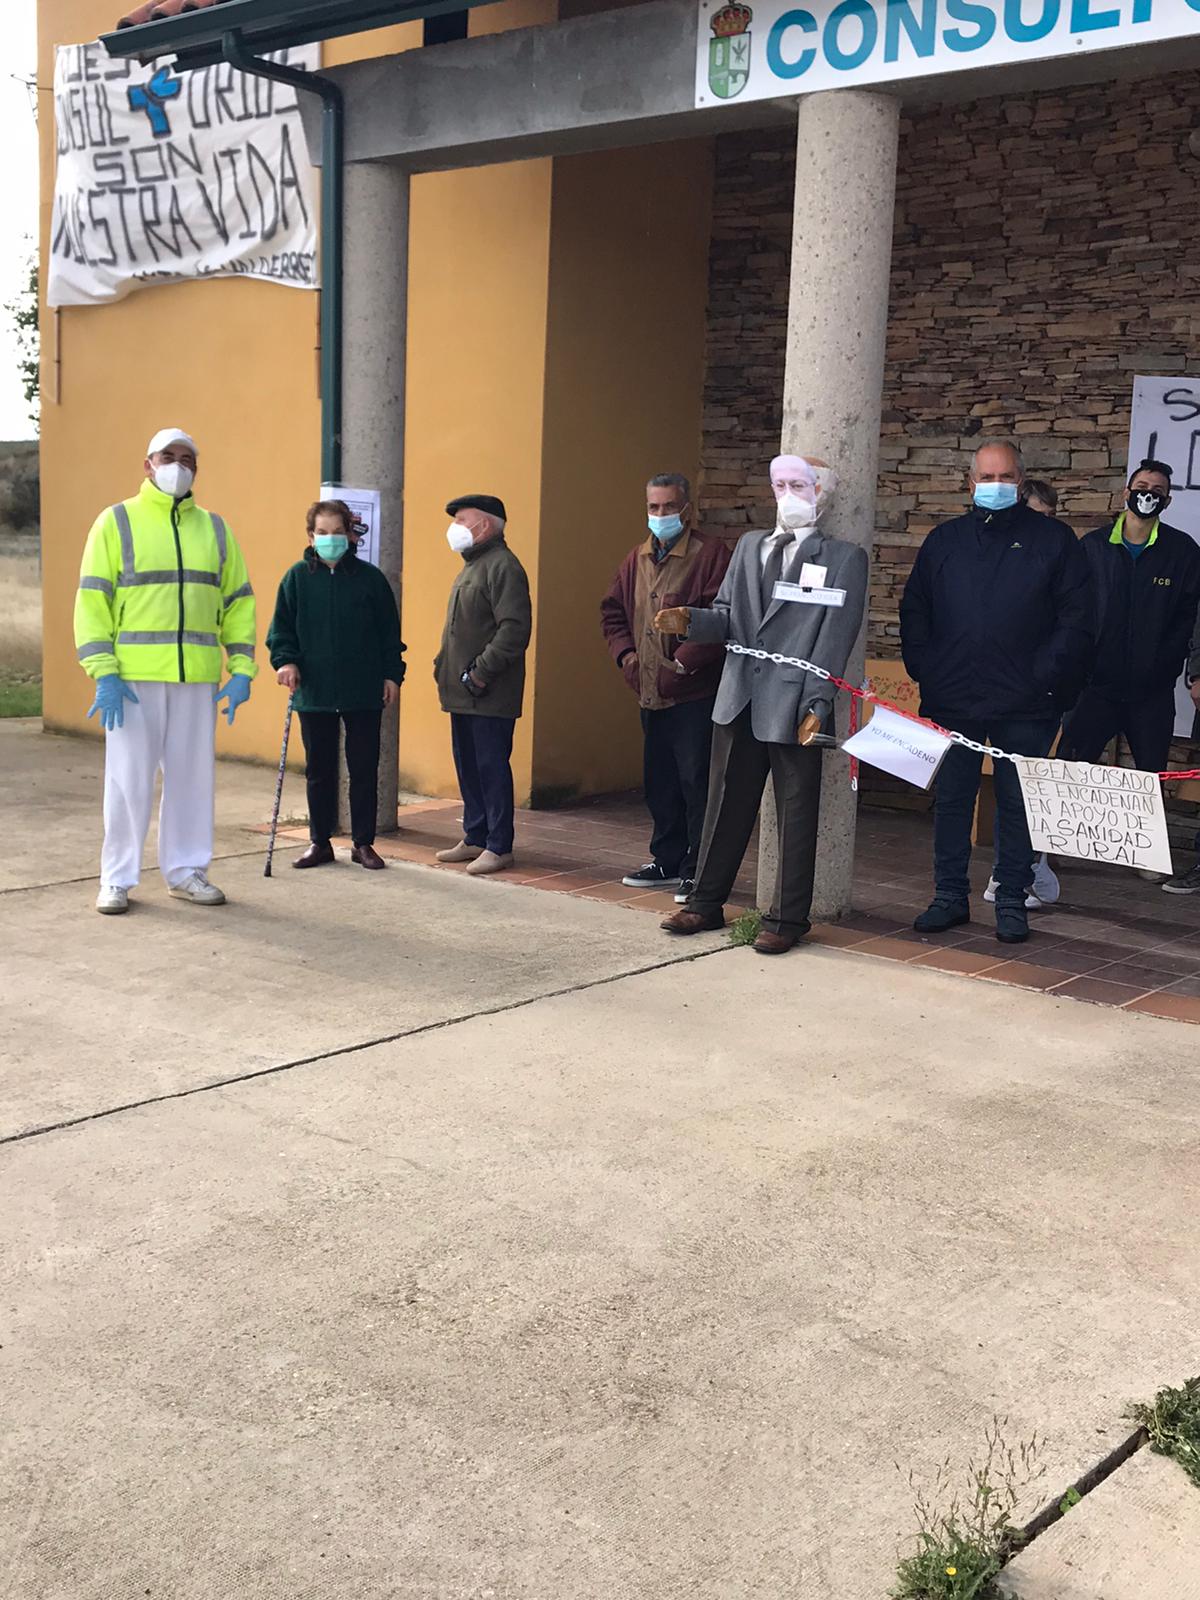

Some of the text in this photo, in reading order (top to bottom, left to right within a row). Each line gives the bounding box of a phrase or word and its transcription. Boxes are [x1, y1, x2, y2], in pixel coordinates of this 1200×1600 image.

[766, 0, 1200, 79] CONSUL
[92, 133, 204, 188] SON
[197, 123, 308, 246] VIDA
[1153, 576, 1171, 586] FCB
[1089, 765, 1156, 794] CASADO
[1025, 780, 1155, 816] SE ENCADENAN
[1028, 798, 1155, 832] EN APOYO DE
[1031, 815, 1153, 849] LA SANIDAD
[1047, 834, 1148, 867] RURAL
